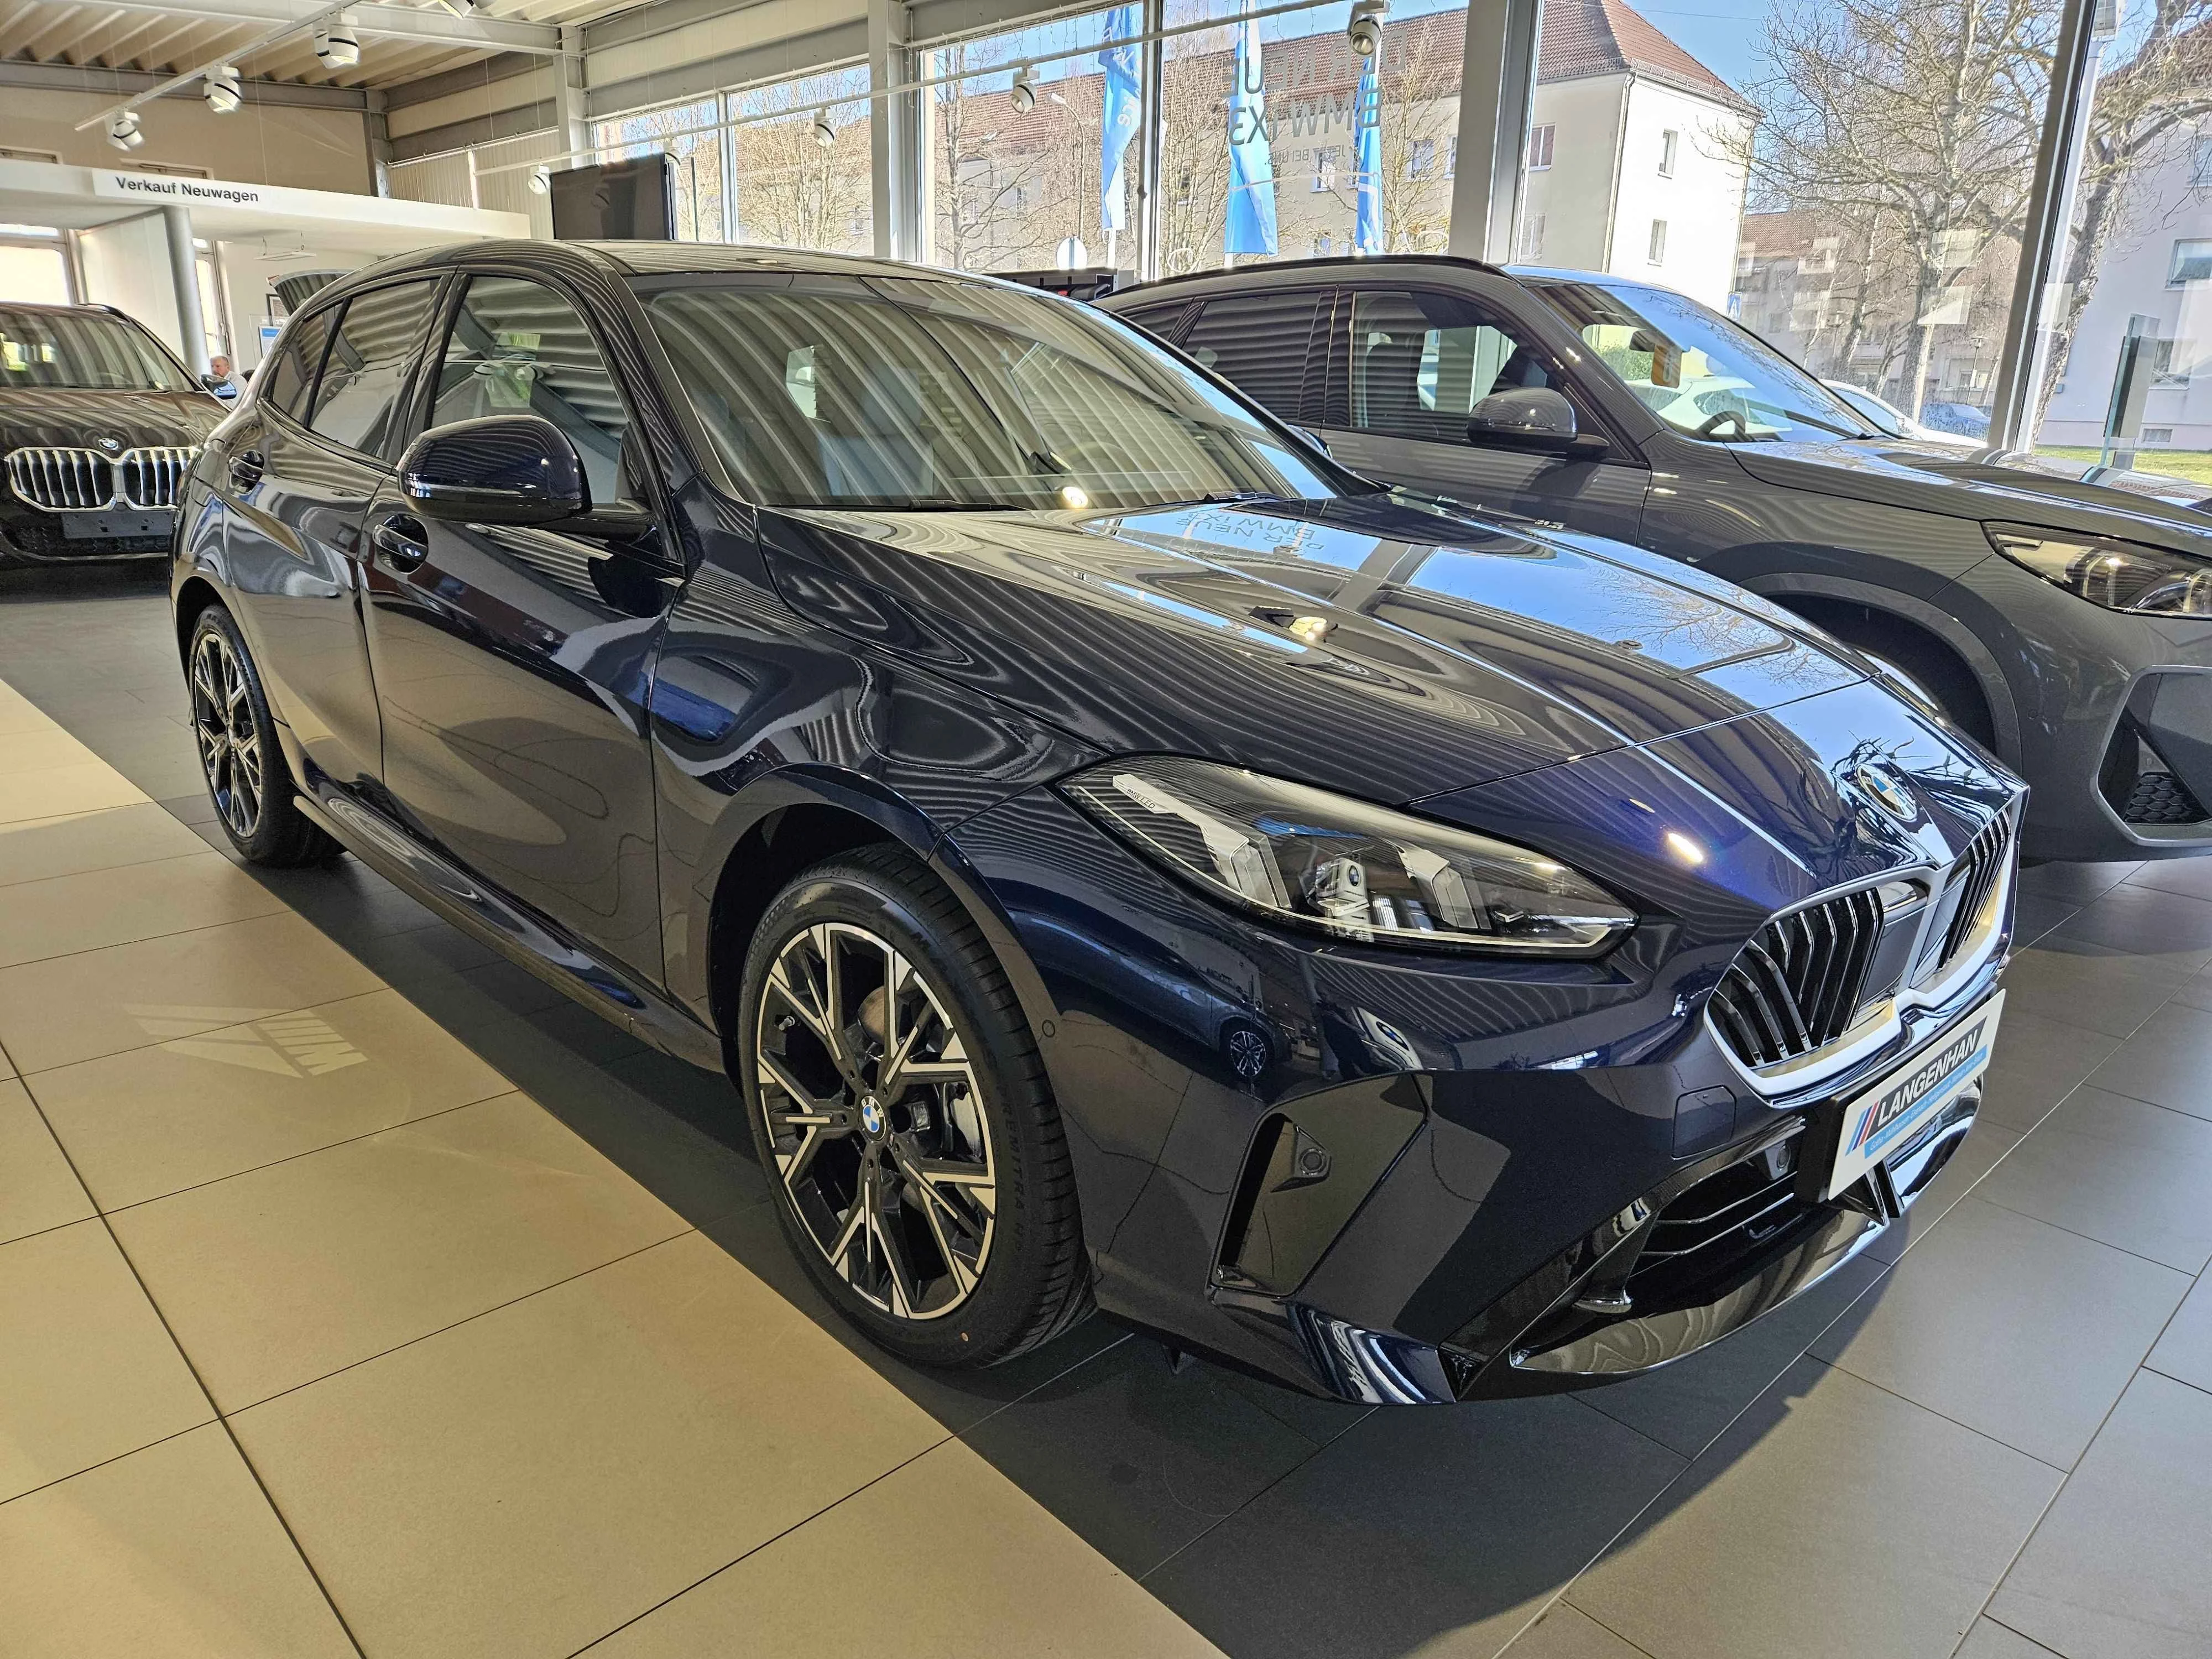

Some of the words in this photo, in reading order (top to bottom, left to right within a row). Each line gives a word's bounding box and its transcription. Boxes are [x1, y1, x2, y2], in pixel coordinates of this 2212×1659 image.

[116, 176, 176, 194] Verkauf
[181, 183, 259, 202] Neuwagen
[1140, 797, 1155, 808] LED
[1878, 1029, 1979, 1126] LANGENHAN
[861, 1097, 884, 1118] BMW
